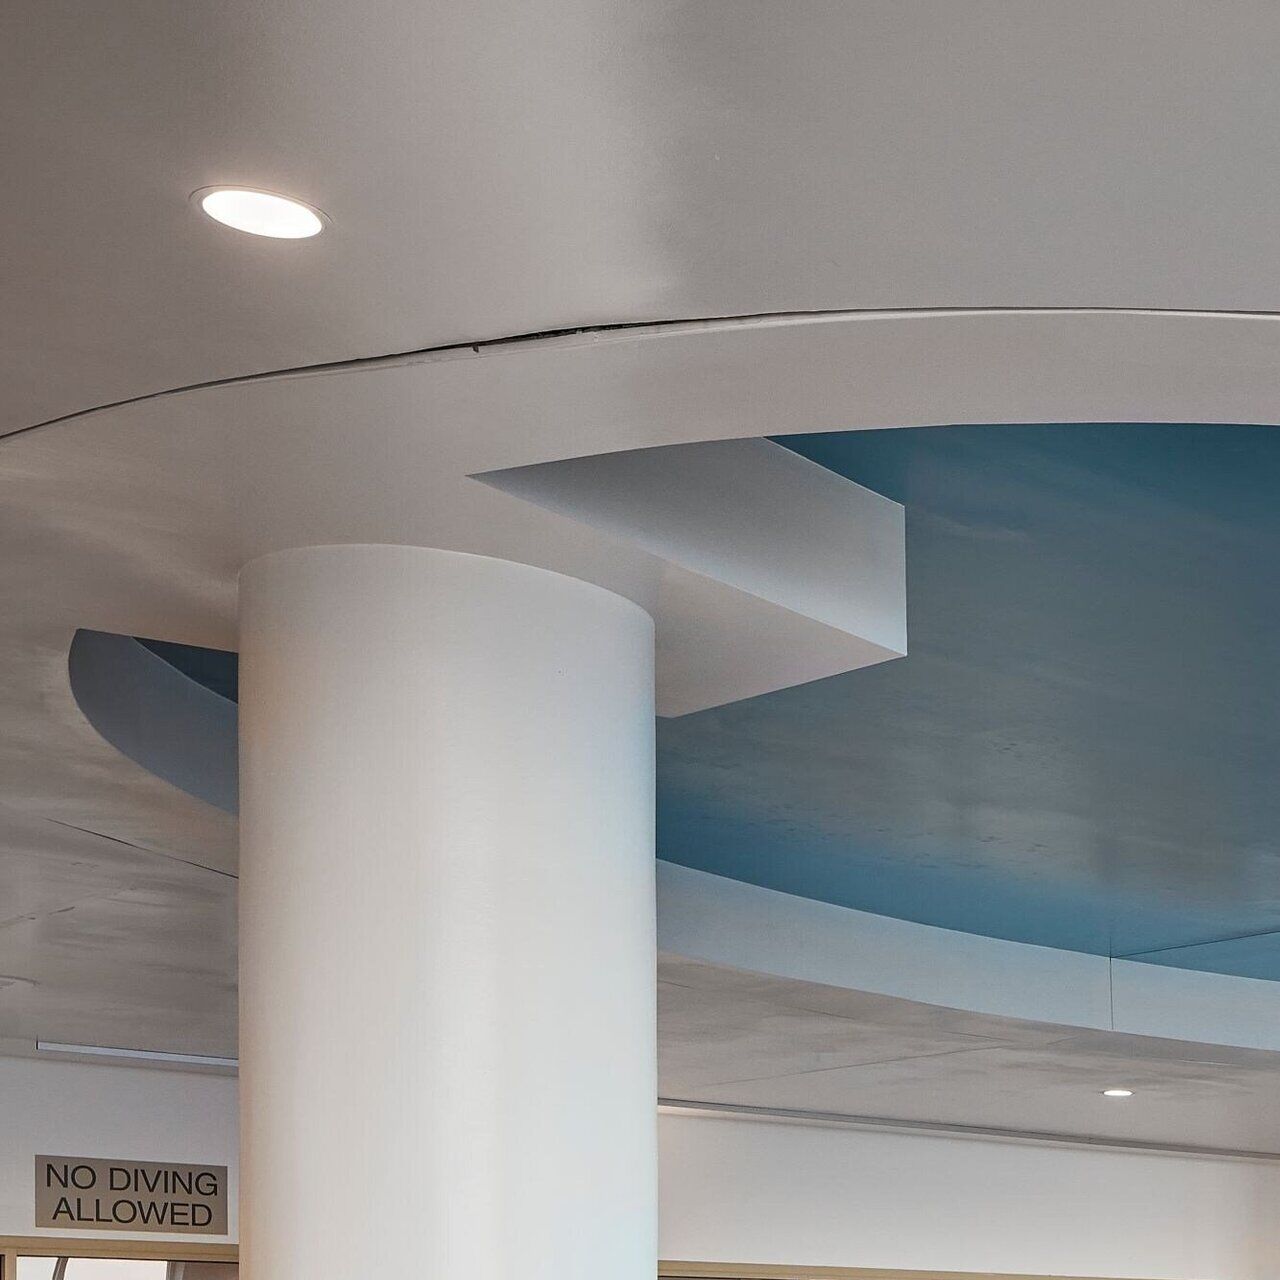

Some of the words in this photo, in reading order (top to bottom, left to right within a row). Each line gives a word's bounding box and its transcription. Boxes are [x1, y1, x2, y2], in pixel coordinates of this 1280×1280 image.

[46, 1163, 97, 1190] NO
[109, 1167, 218, 1196] DIVING
[52, 1197, 213, 1227] ALLOWED
